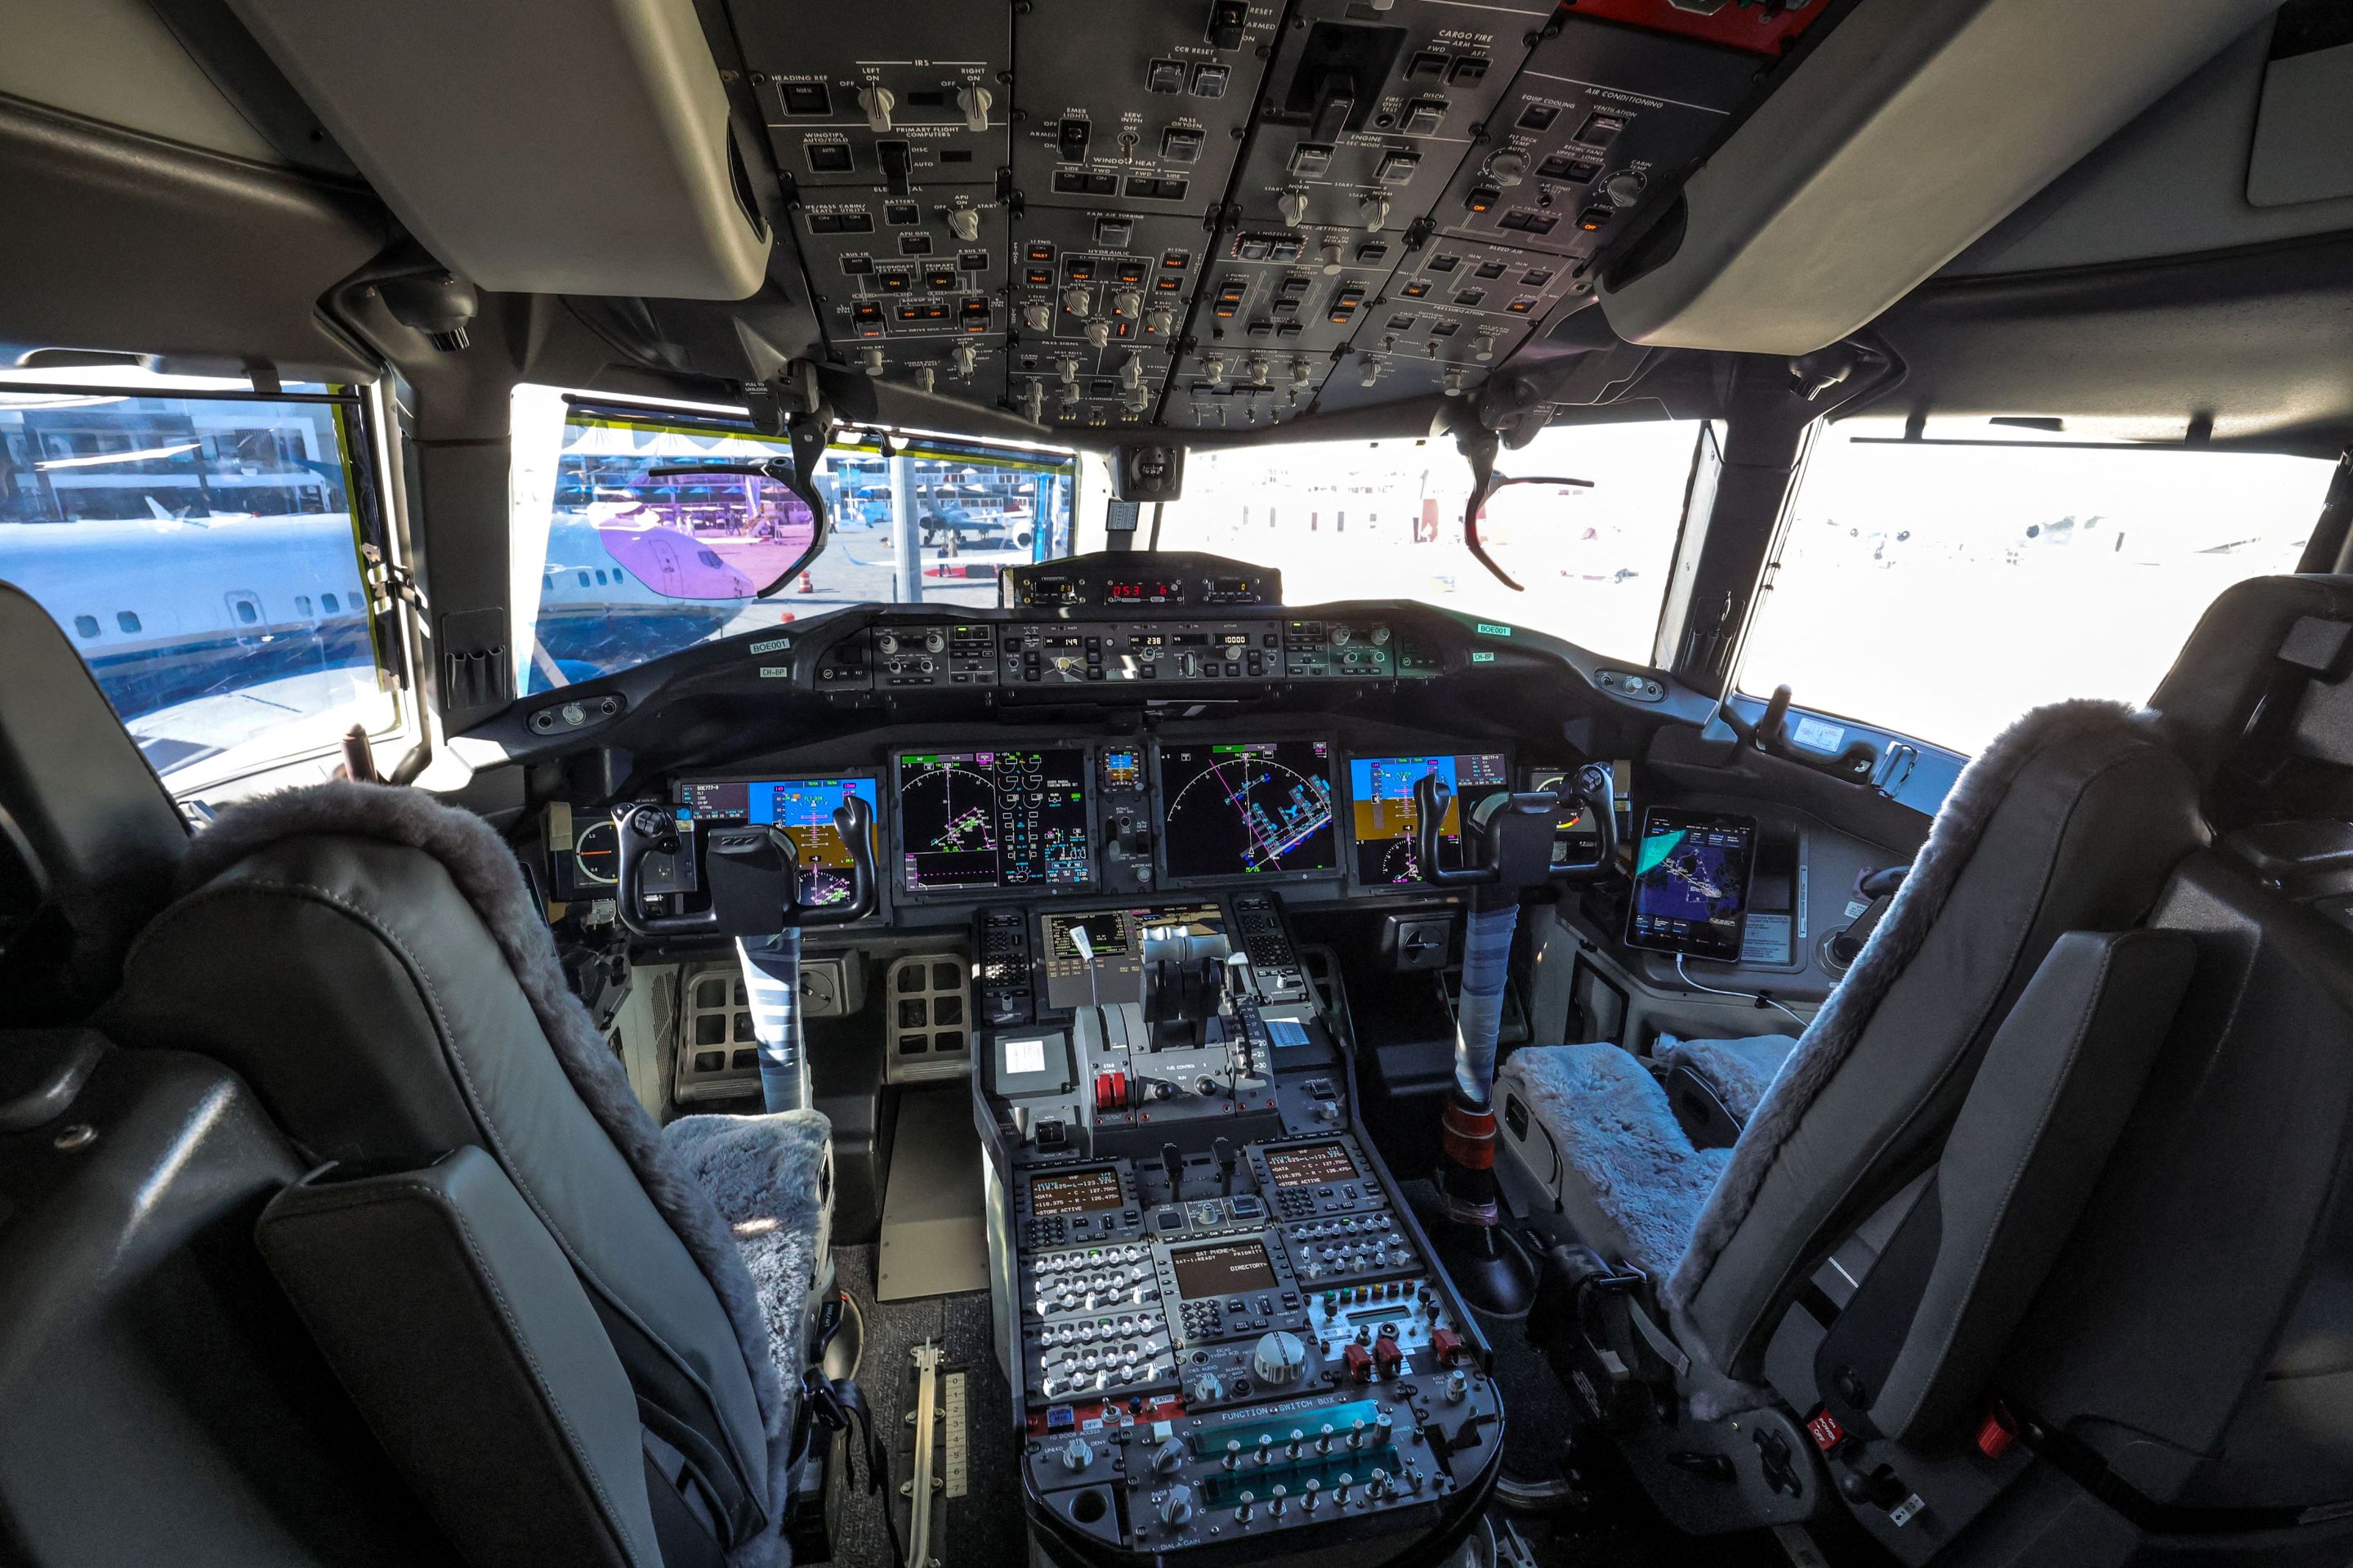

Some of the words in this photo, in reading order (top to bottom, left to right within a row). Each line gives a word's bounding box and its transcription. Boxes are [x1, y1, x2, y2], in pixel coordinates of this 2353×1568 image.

[1249, 7, 1273, 16] RESET
[1246, 22, 1275, 30] ARMED
[1439, 29, 1472, 41] CARGO
[1474, 34, 1494, 42] FIRE
[1521, 93, 1543, 102] EQUIP
[1542, 97, 1575, 109] COOLING
[1584, 87, 1601, 96] AIR
[1602, 90, 1663, 109] CONDITIONING
[1593, 104, 1636, 118] VENTILATION
[1172, 121, 1202, 129] OXYGEN
[1351, 134, 1382, 142] ENGINE
[1113, 585, 1141, 596] 053
[1159, 586, 1167, 595] 6
[1480, 625, 1507, 634] BOE001
[753, 641, 787, 653] BOE001
[762, 668, 784, 677] CH-BP
[721, 836, 757, 845] 777
[1210, 1247, 1236, 1255] PHONE-L
[1233, 1249, 1262, 1258] PRIORITY
[1222, 1406, 1268, 1421] FUNCTION
[1279, 1400, 1313, 1413] SWITCH
[1318, 1396, 1335, 1405] BOX
[1819, 1418, 1836, 1441] POWER
[1814, 1428, 1825, 1441] OFF
